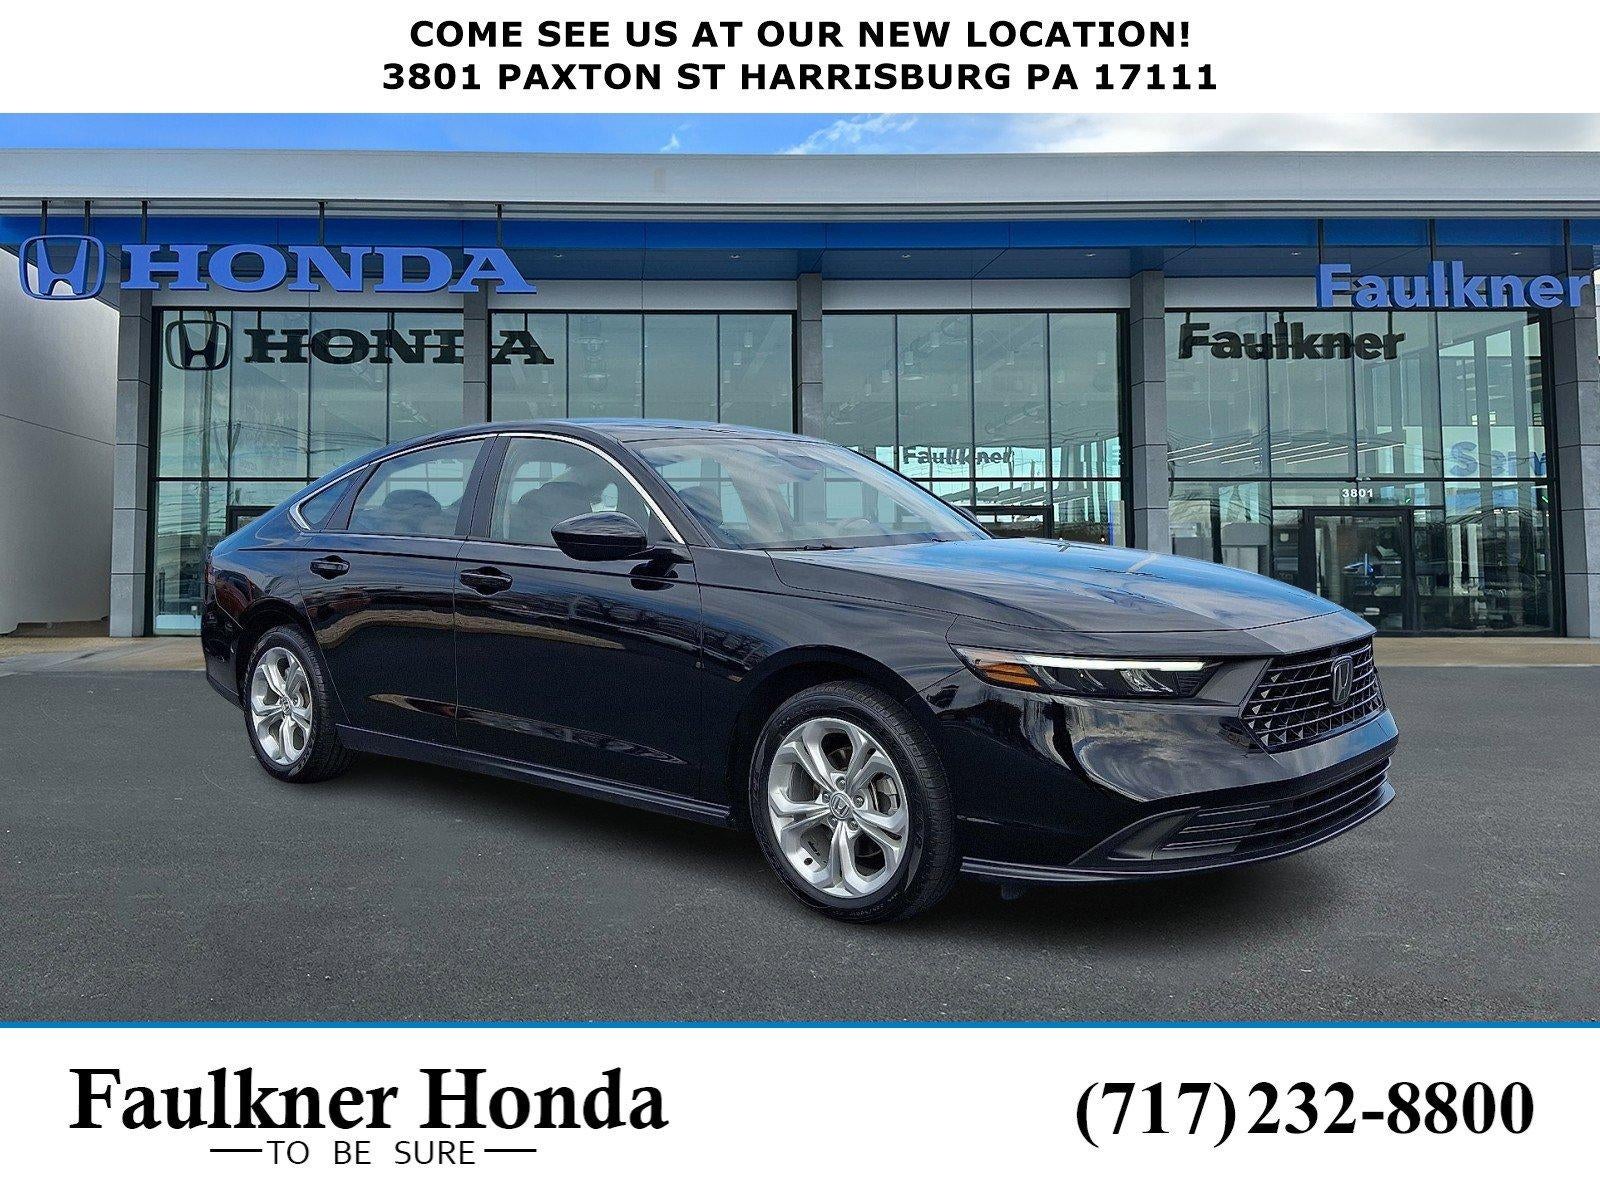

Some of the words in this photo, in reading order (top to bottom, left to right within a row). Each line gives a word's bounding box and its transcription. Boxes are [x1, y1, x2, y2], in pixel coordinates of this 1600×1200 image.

[120, 243, 538, 295] HONDA
[1317, 260, 1591, 309] Faulkner
[1178, 321, 1407, 361] Faulkner
[1341, 488, 1374, 498] 3801
